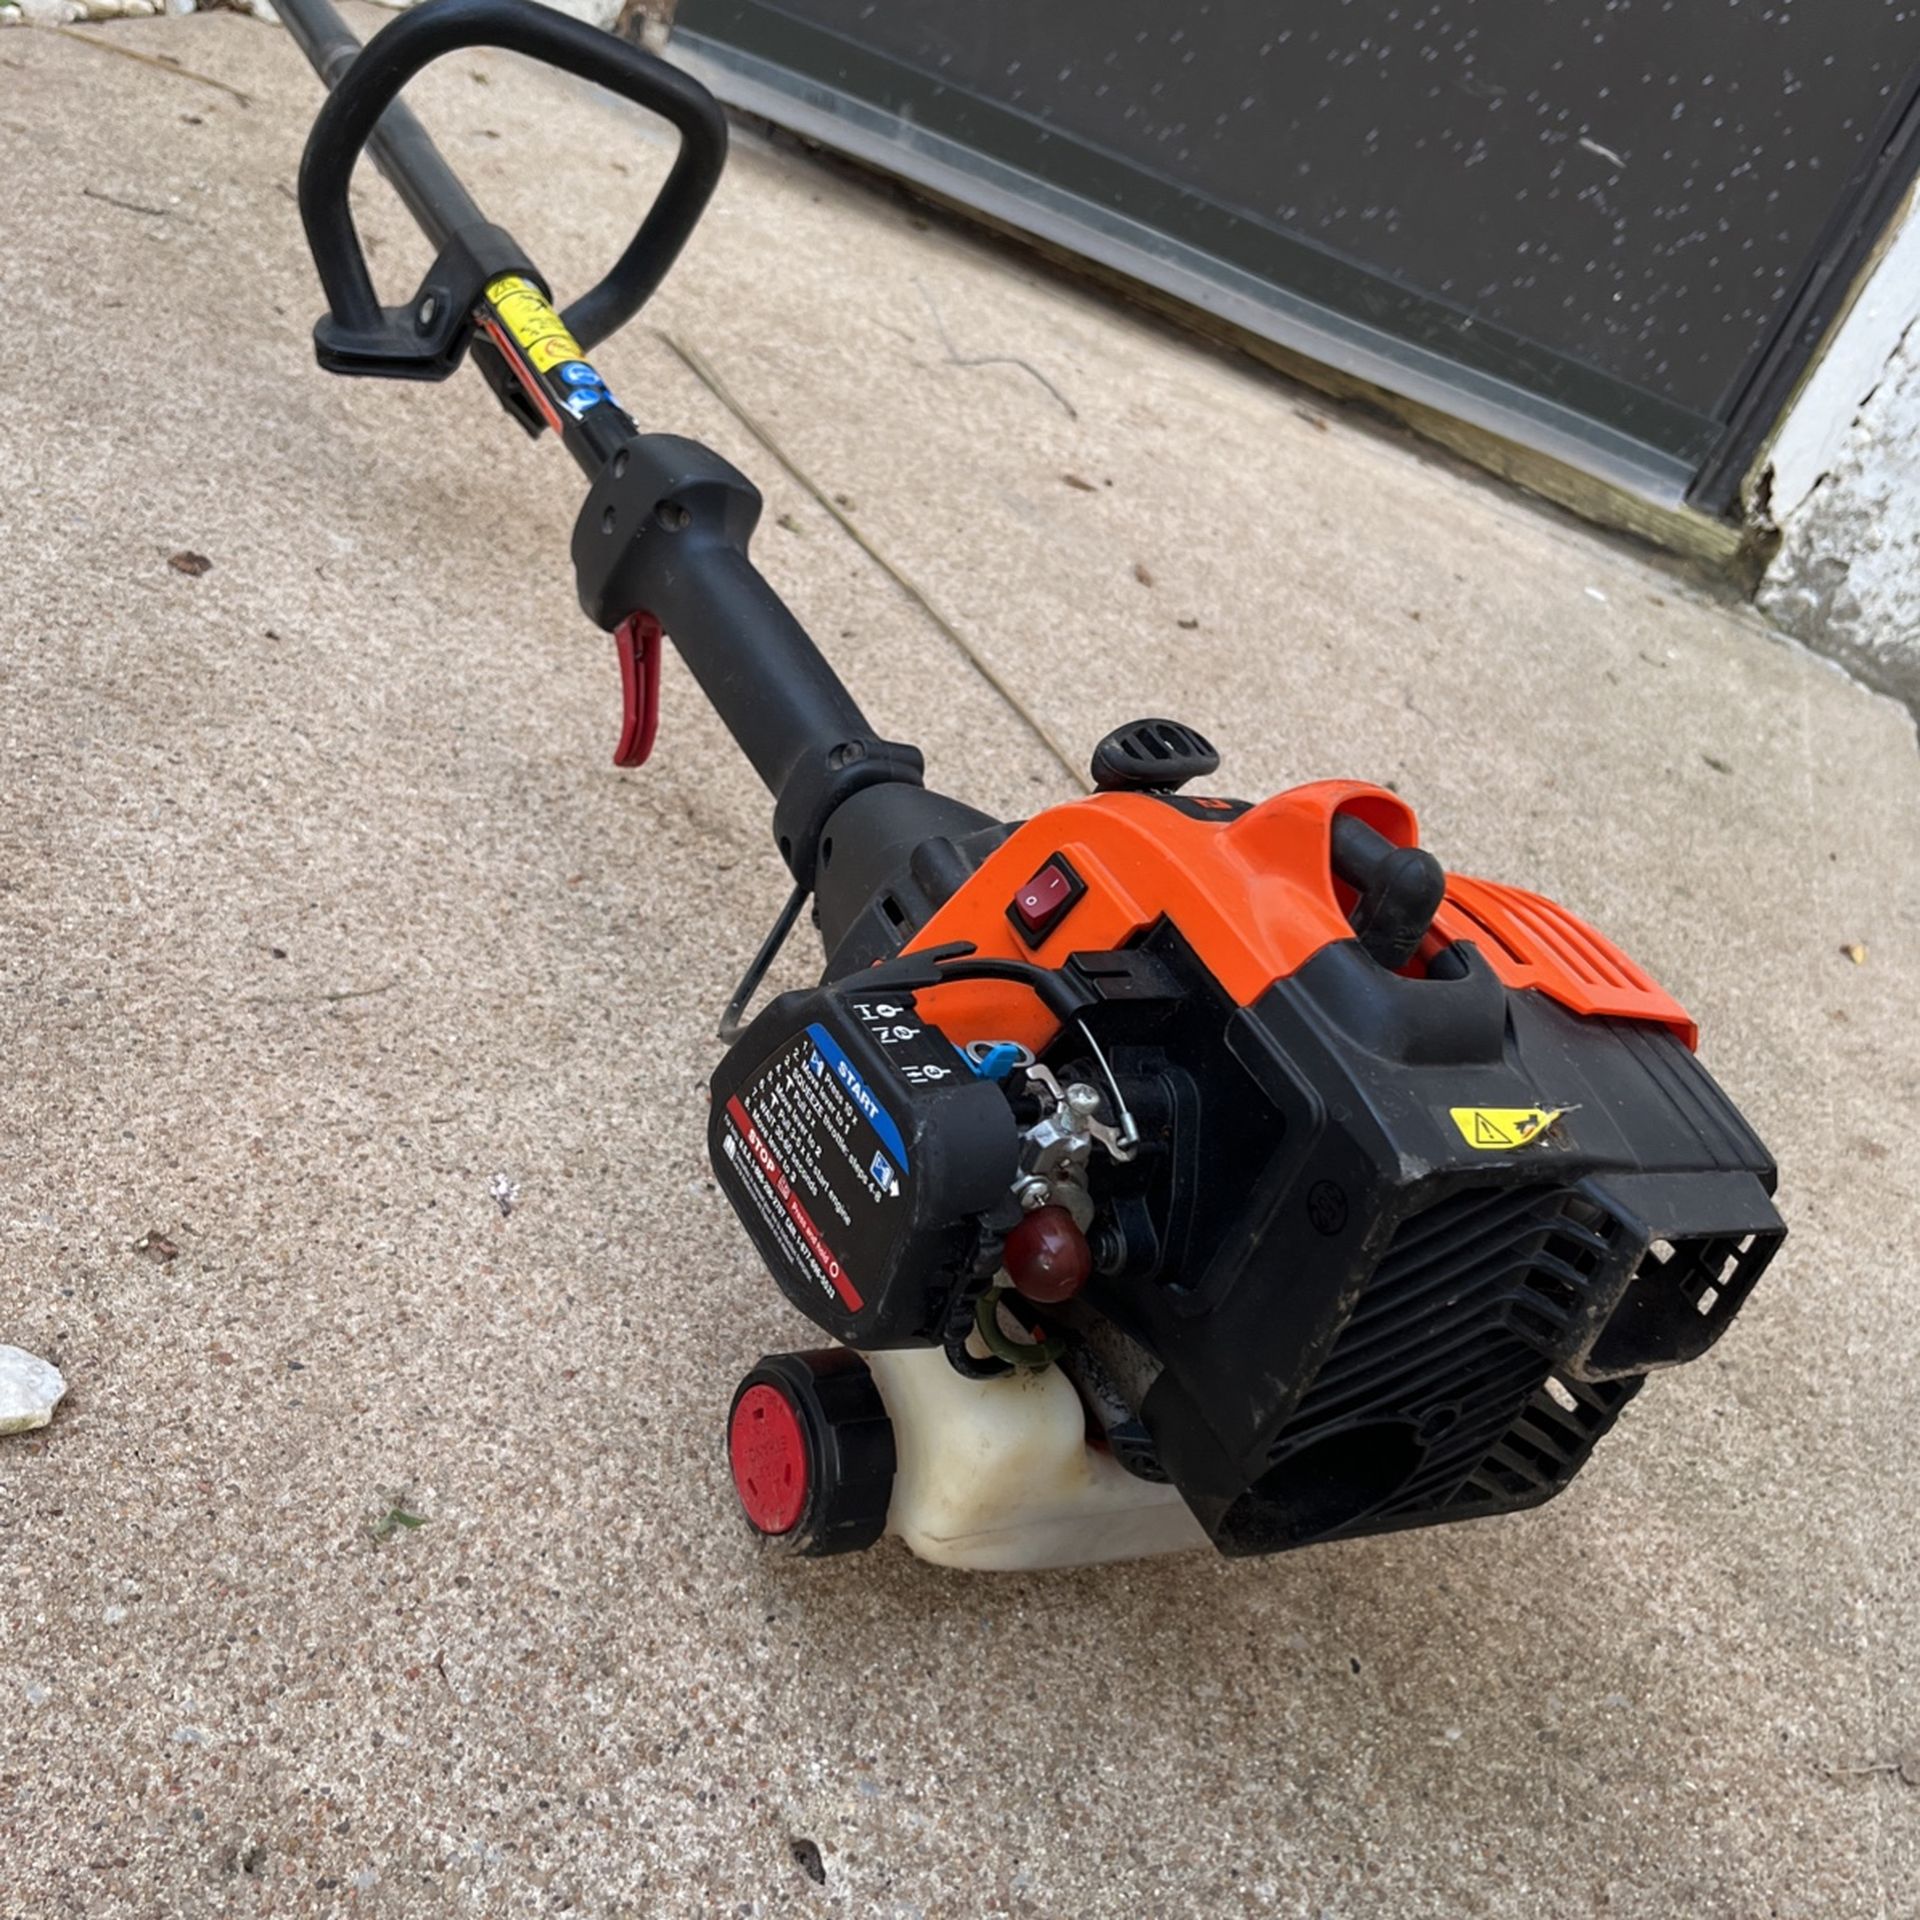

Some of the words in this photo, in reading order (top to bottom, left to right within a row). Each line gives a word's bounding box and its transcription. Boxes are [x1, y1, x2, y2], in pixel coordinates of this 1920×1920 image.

[775, 1082, 792, 1112] Move
[791, 1109, 808, 1136] lever
[807, 1133, 815, 1149] to
[815, 1146, 822, 1157] 2
[792, 1067, 824, 1118] SQUEEZE
[848, 1154, 868, 1184] steps
[793, 1090, 807, 1113] Pull
[801, 1059, 819, 1090] Move
[819, 1086, 836, 1113] lever
[835, 1111, 844, 1126] to
[844, 1124, 850, 1134] 1
[824, 1072, 843, 1105] Press
[844, 1102, 853, 1117] 10
[838, 1061, 879, 1118] START
[752, 1108, 768, 1138] Move
[768, 1134, 783, 1161] lever
[782, 1159, 790, 1174] to
[760, 1099, 776, 1127] WAIT
[791, 1153, 817, 1196] seconds
[778, 1108, 791, 1131] Pull
[805, 1152, 813, 1167] to
[813, 1166, 829, 1192] start
[828, 1190, 851, 1226] engine
[748, 1129, 775, 1171] STOP
[791, 1201, 807, 1228] Press
[806, 1227, 817, 1245] and
[816, 1242, 829, 1264] hold
